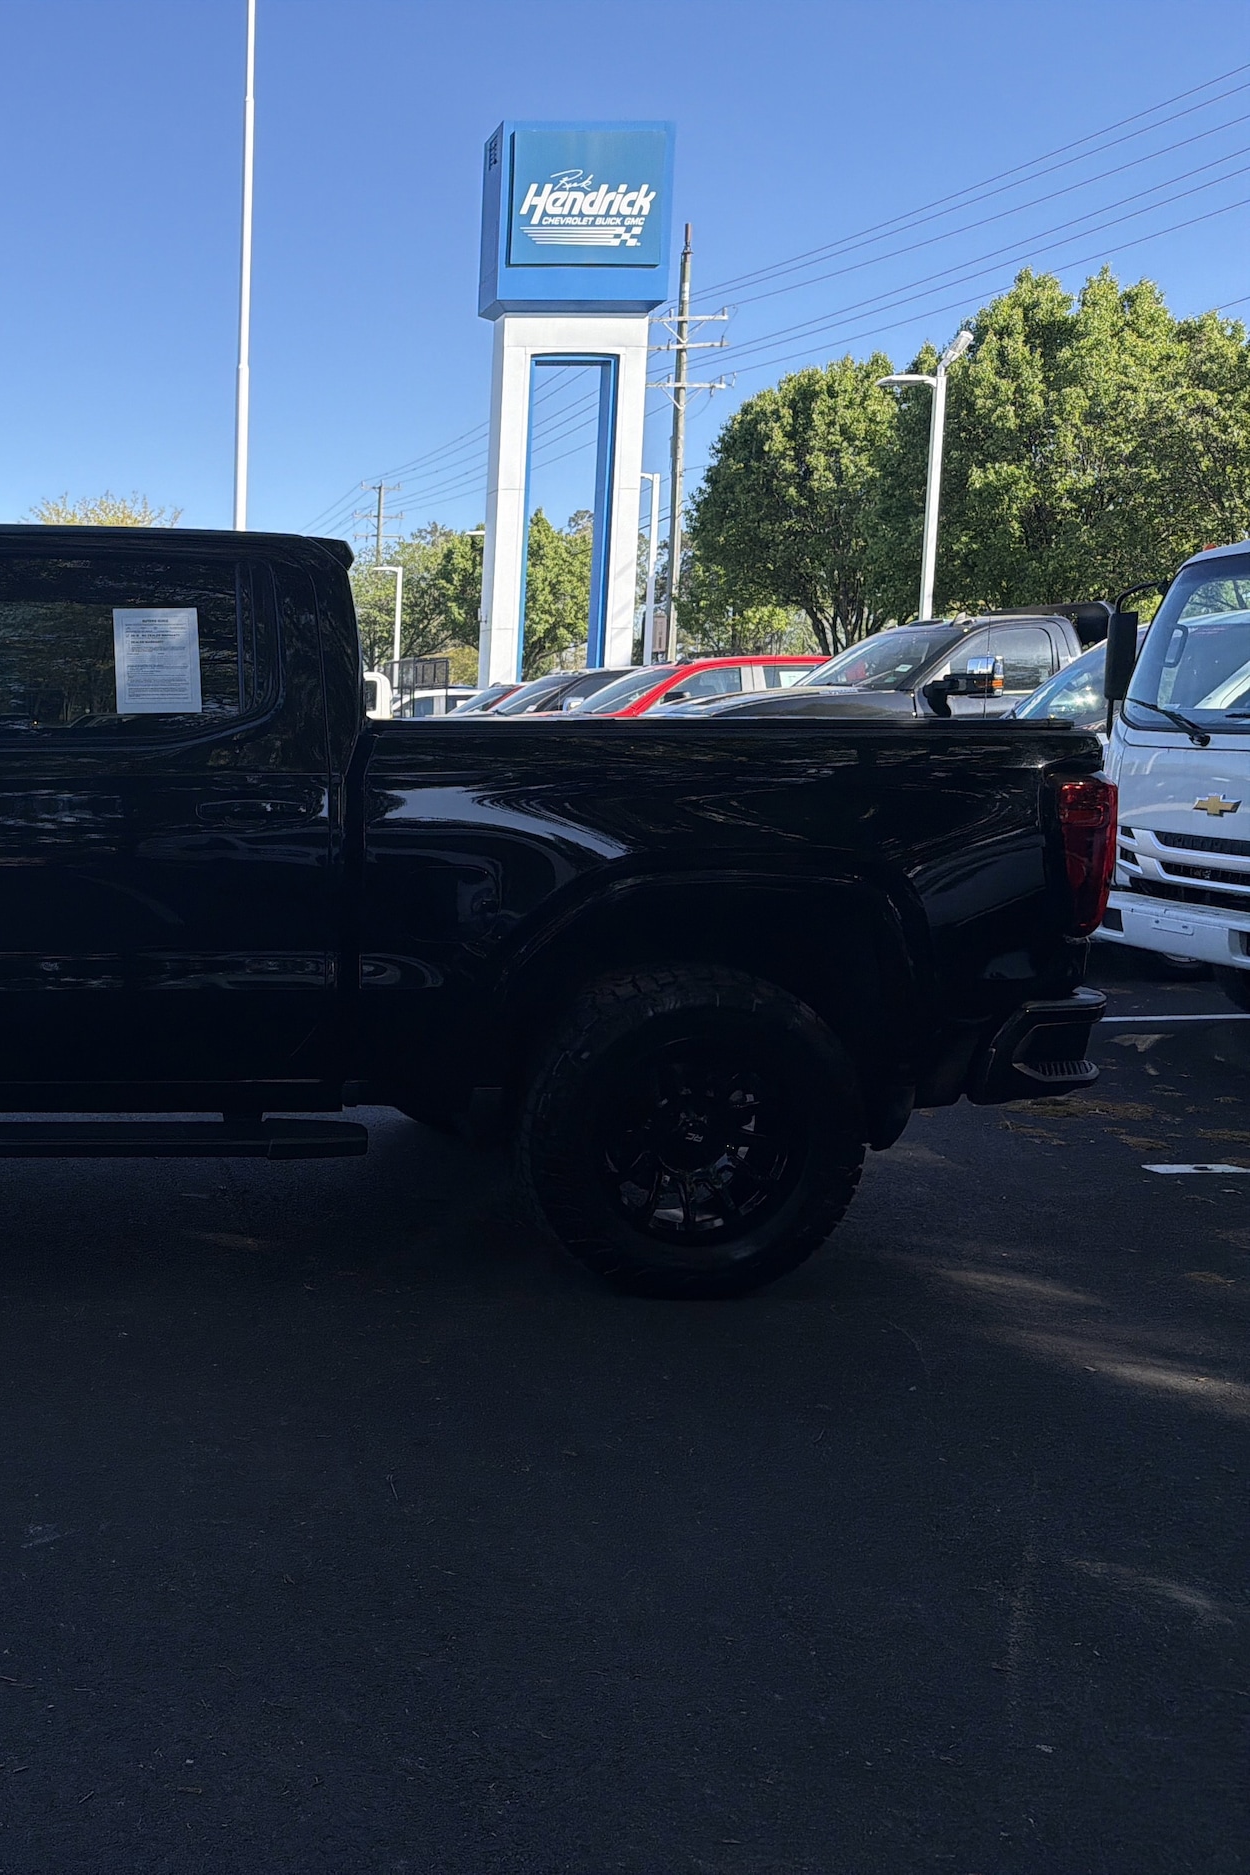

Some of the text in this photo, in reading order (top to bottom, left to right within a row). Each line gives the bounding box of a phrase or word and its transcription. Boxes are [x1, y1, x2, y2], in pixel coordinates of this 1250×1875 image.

[519, 183, 657, 225] Hendrick
[542, 216, 646, 226] CHEVROLET BUICK GMC
